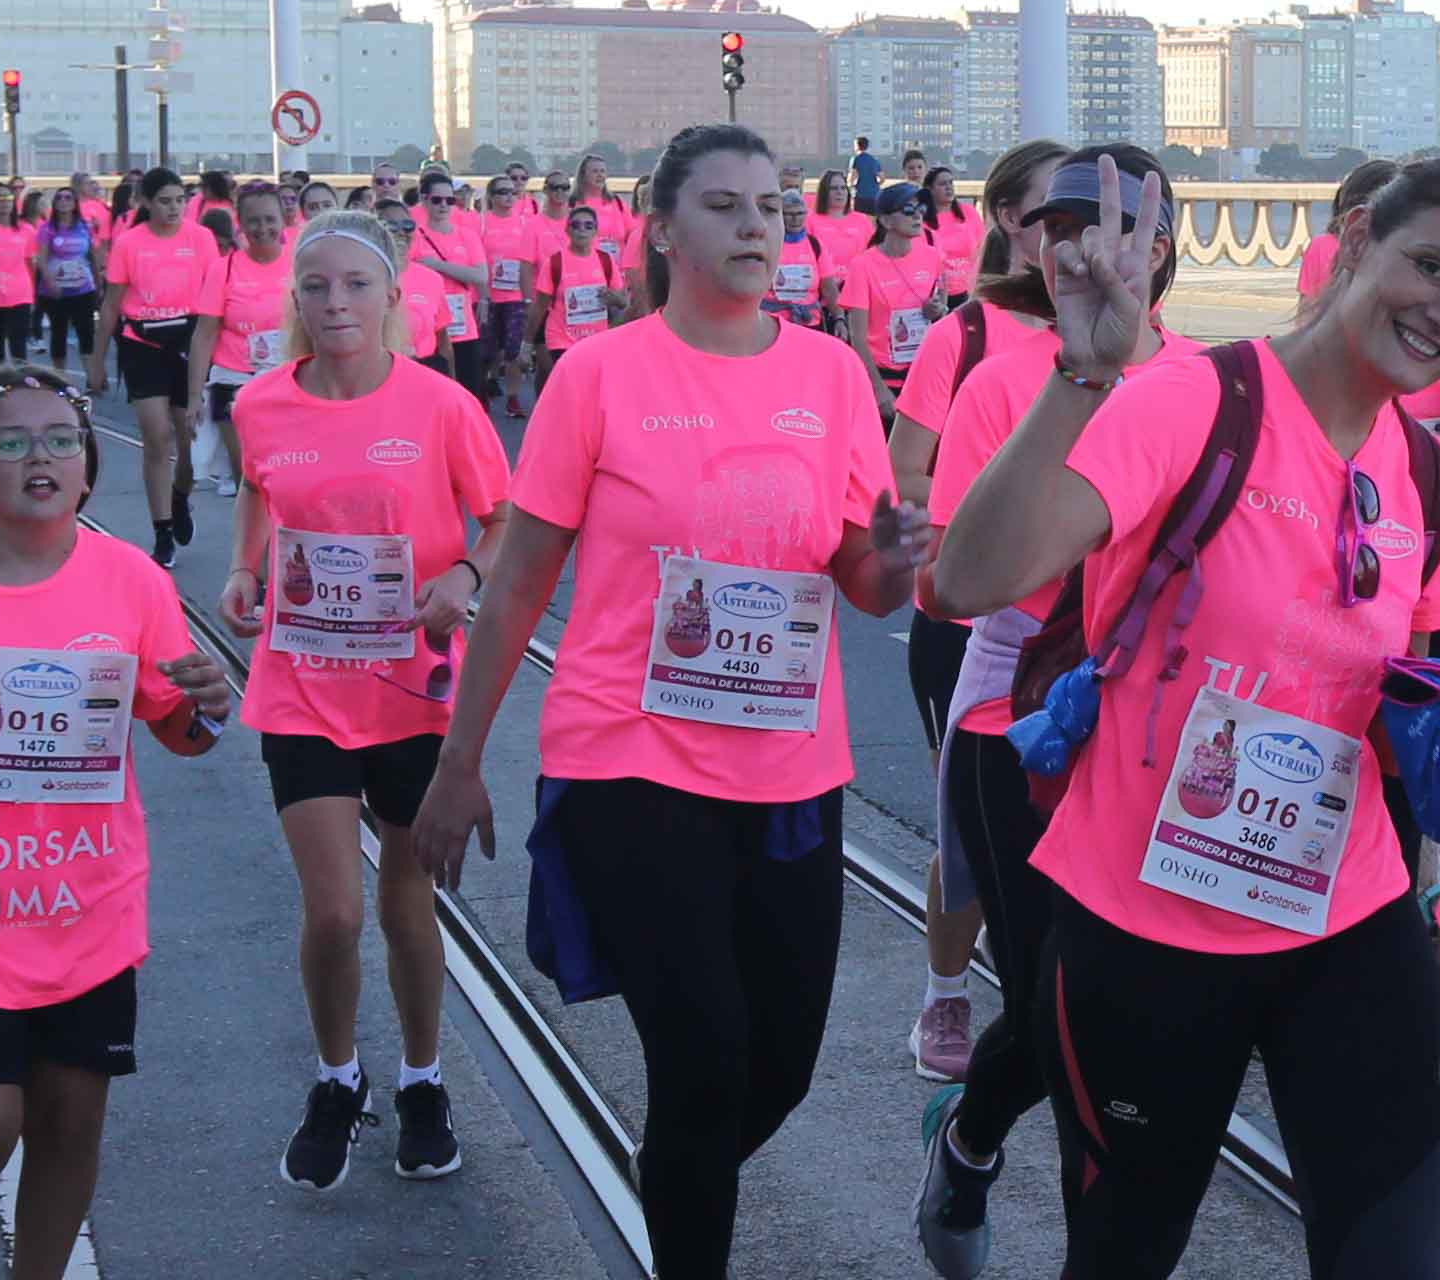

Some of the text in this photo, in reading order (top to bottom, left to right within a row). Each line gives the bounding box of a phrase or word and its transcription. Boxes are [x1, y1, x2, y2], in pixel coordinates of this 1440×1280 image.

[643, 413, 715, 432] OYSHO
[317, 583, 362, 601] 016
[720, 591, 782, 611] ASTURIANA
[325, 607, 353, 618] 1473
[716, 629, 774, 654] 016
[722, 659, 759, 674] 4430
[9, 676, 75, 690] ASTURIANA
[668, 671, 716, 687] CARRERA
[718, 679, 732, 688] DE
[735, 681, 747, 689] LA
[749, 682, 783, 693] MUJER
[660, 690, 714, 710] OYSHO
[757, 704, 806, 717] Santander
[8, 710, 69, 733] 016
[18, 740, 56, 753] 1476
[14, 758, 29, 767] DE
[32, 759, 45, 768] LA
[47, 759, 82, 768] MUJER
[1251, 744, 1317, 779] ASTURIANA
[1237, 788, 1300, 829] 016
[1239, 827, 1278, 852] 3486
[1174, 834, 1227, 860] CARRERA
[1229, 852, 1246, 865] DE
[1247, 856, 1260, 869] LA
[1260, 861, 1292, 878] MUJER
[1160, 856, 1219, 889] OYSHO
[1259, 889, 1312, 916] Santander
